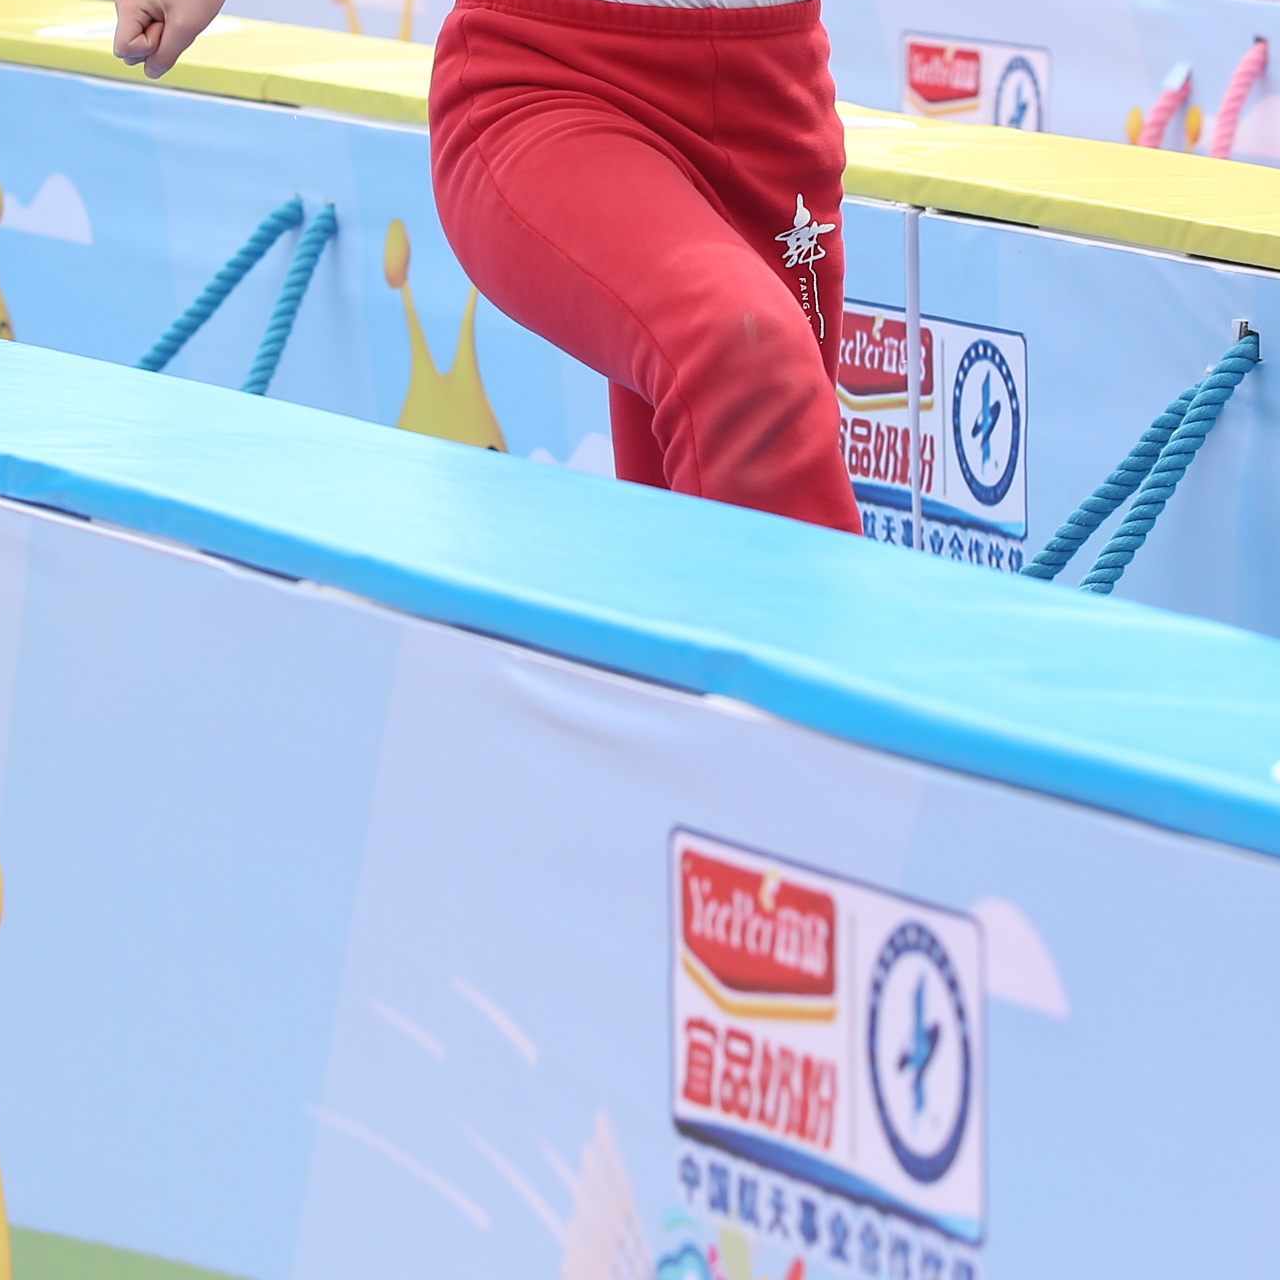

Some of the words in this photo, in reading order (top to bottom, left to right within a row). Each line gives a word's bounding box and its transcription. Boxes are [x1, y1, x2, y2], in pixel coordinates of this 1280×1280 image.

[798, 277, 811, 310] FANG
[839, 330, 883, 370] eePer
[682, 1013, 839, 1154] 宜品奶粉
